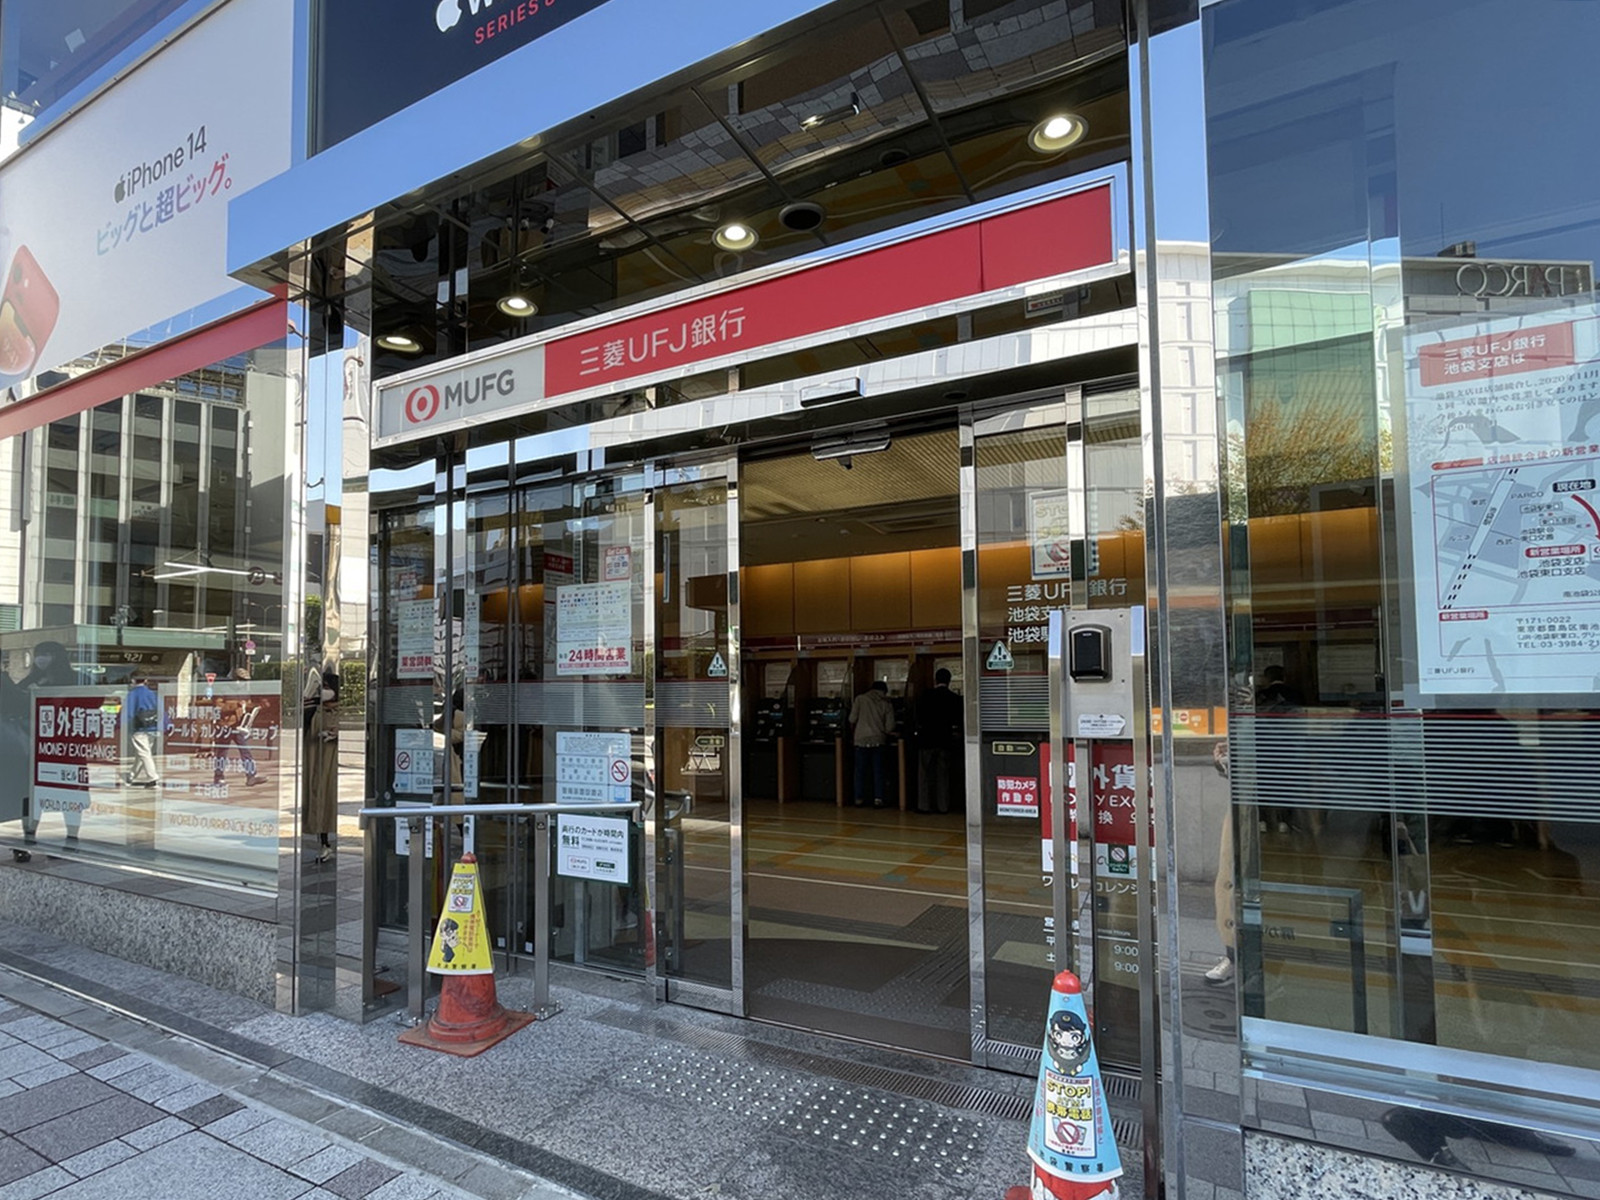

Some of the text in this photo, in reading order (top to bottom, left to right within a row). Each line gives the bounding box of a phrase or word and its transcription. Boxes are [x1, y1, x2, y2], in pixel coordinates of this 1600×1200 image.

[474, 3, 539, 45] SERIES
[126, 125, 207, 197] iPhone 14
[579, 307, 746, 376] 三菱UFJ銀行
[1444, 334, 1546, 362] 三菱UFJ銀行
[1444, 352, 1526, 376] 池袋支店は
[444, 368, 515, 411] MUFG
[1518, 567, 1586, 578] 池袋東口支店
[1540, 557, 1586, 567] 池袋支店
[1007, 578, 1127, 602] 三菱UF銀行
[57, 706, 117, 739] 外貨両替
[38, 741, 117, 760] MONEY EXCHANGE
[1114, 944, 1139, 957] 9:00
[1114, 962, 1140, 974] 9:00
[1046, 1080, 1092, 1099] STOP!
